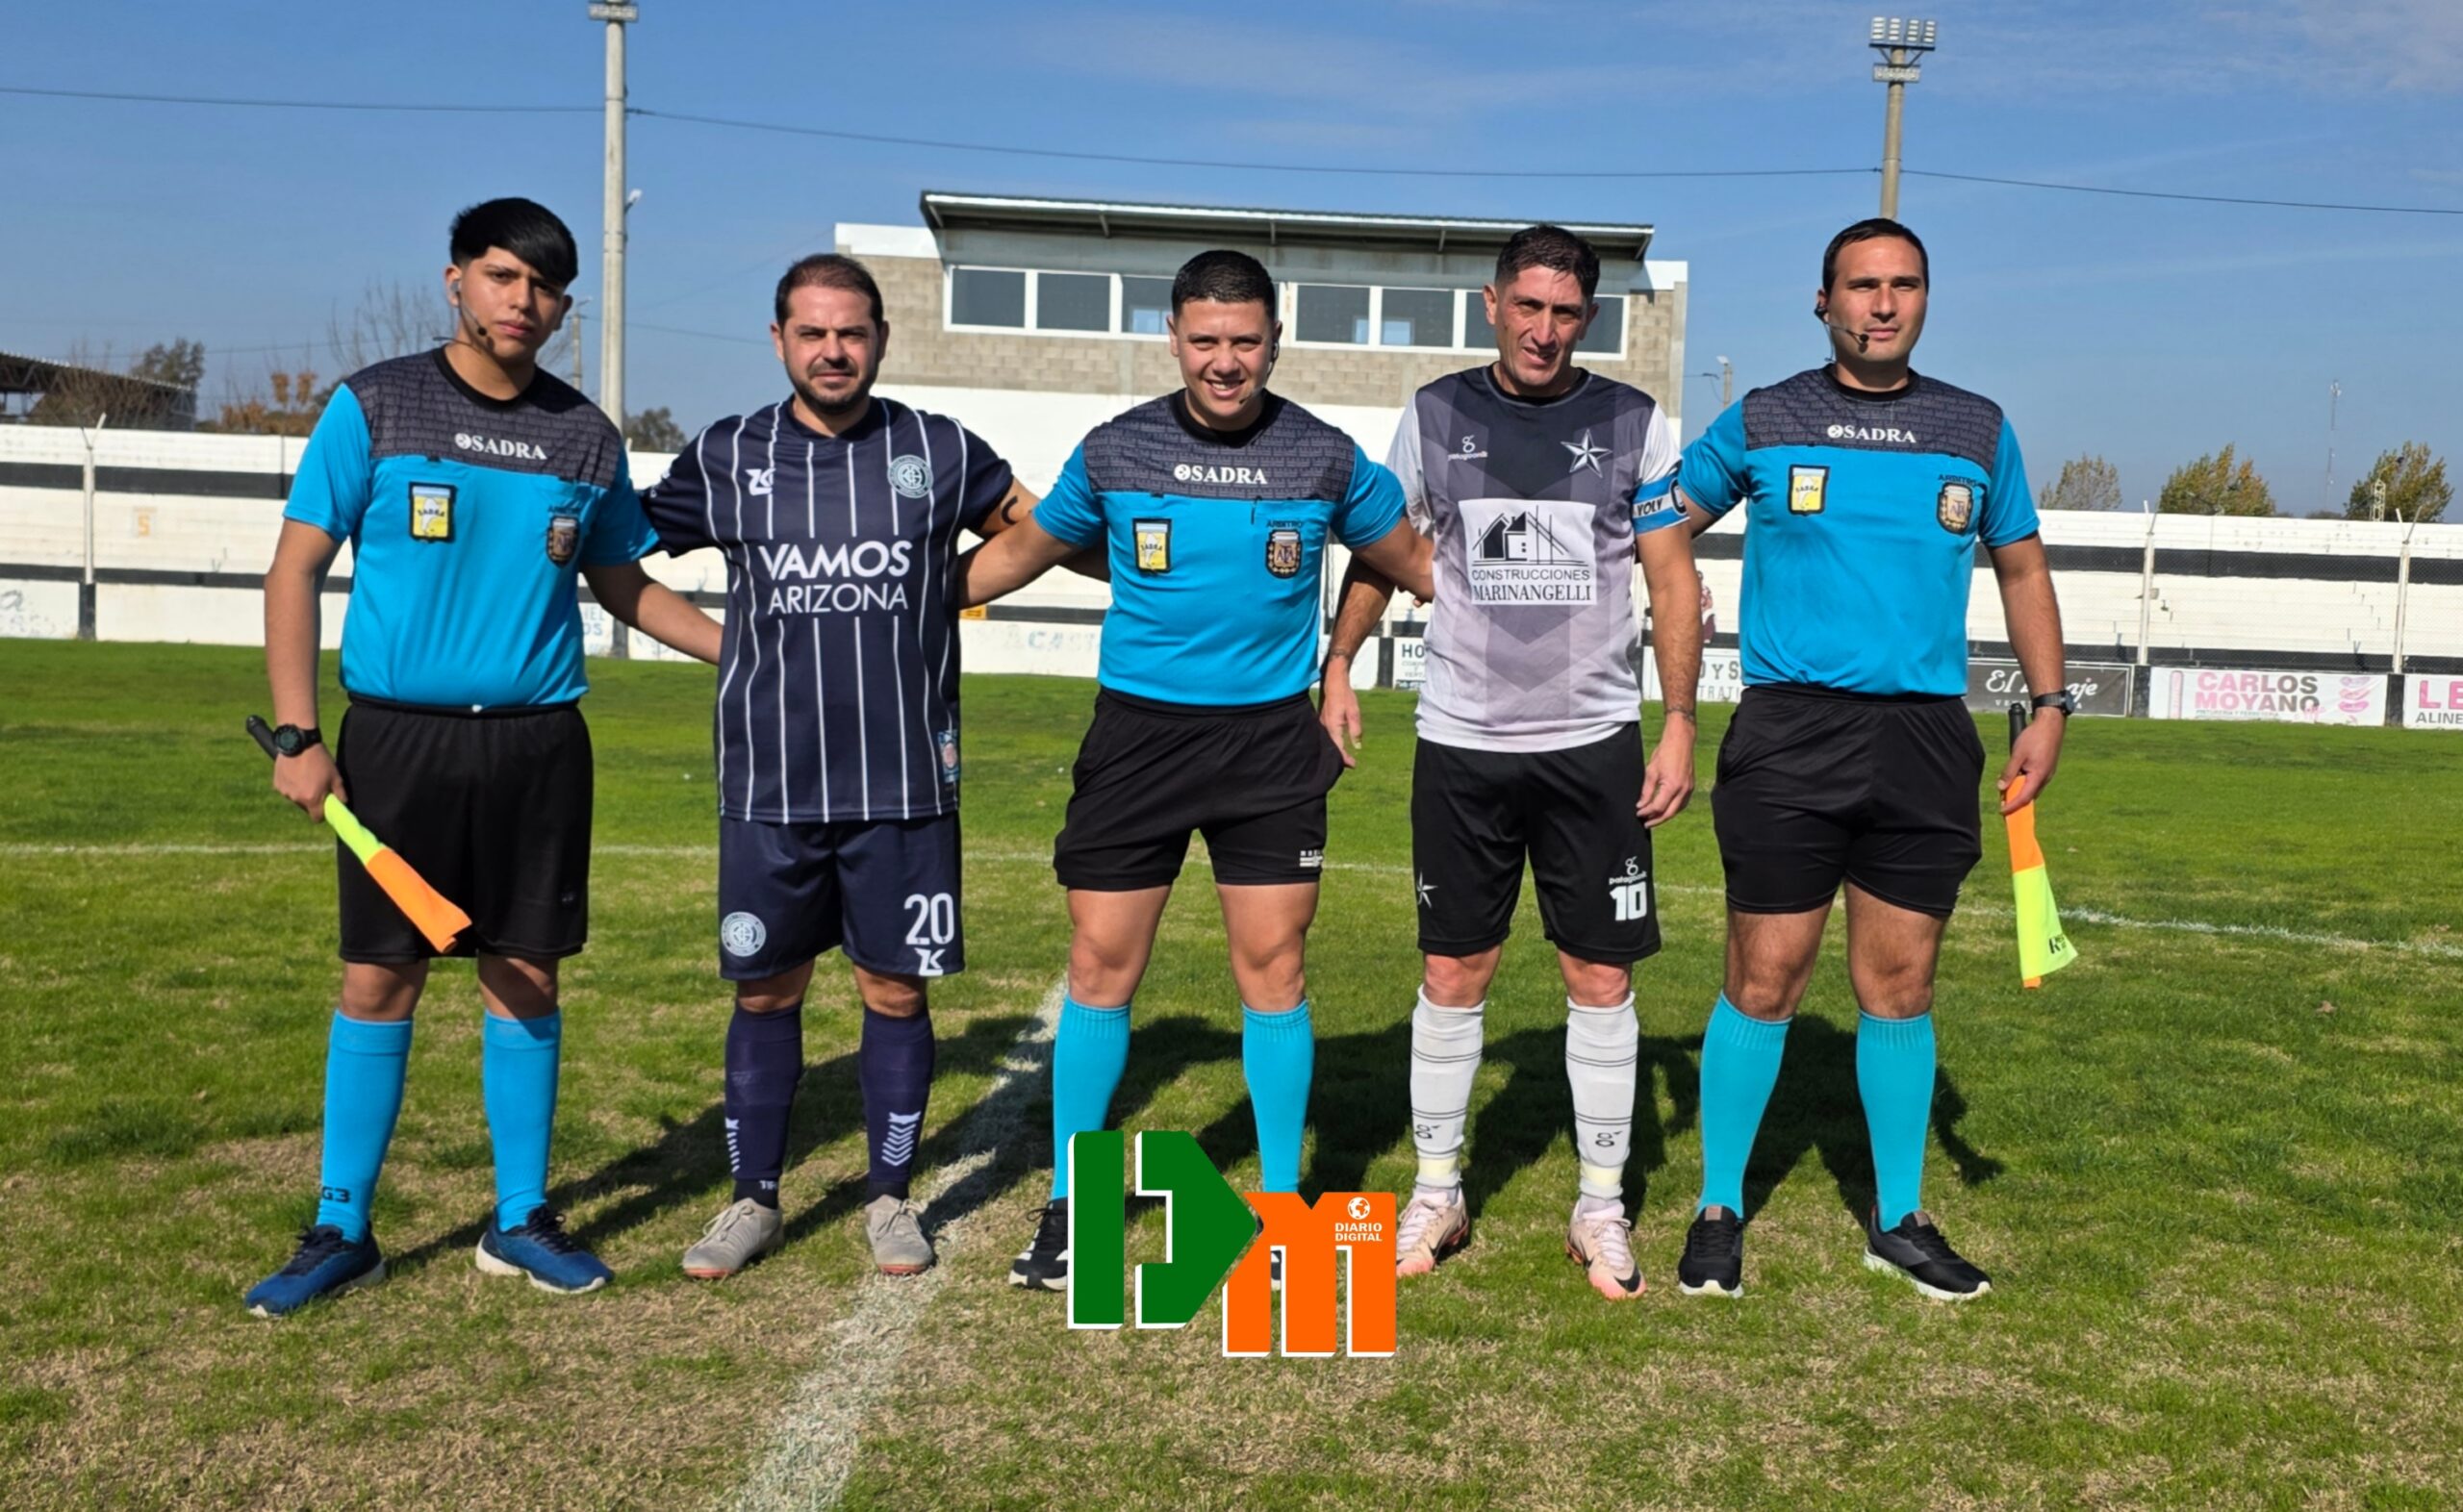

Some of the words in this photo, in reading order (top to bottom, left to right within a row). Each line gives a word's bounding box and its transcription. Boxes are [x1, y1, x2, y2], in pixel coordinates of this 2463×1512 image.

[1844, 424, 1917, 443] SADRA
[471, 435, 546, 460] SADRA
[1191, 466, 1267, 485] SADRA
[758, 541, 912, 581] VAMOS
[1472, 568, 1590, 582] CONSTRUCCIONES
[768, 582, 908, 616] ARIZONA
[1474, 584, 1590, 601] MARINANGELLI
[2197, 672, 2318, 694] CARLOS
[2195, 693, 2321, 713] MOYANO
[1610, 881, 1647, 920] 10
[903, 893, 954, 945] 20
